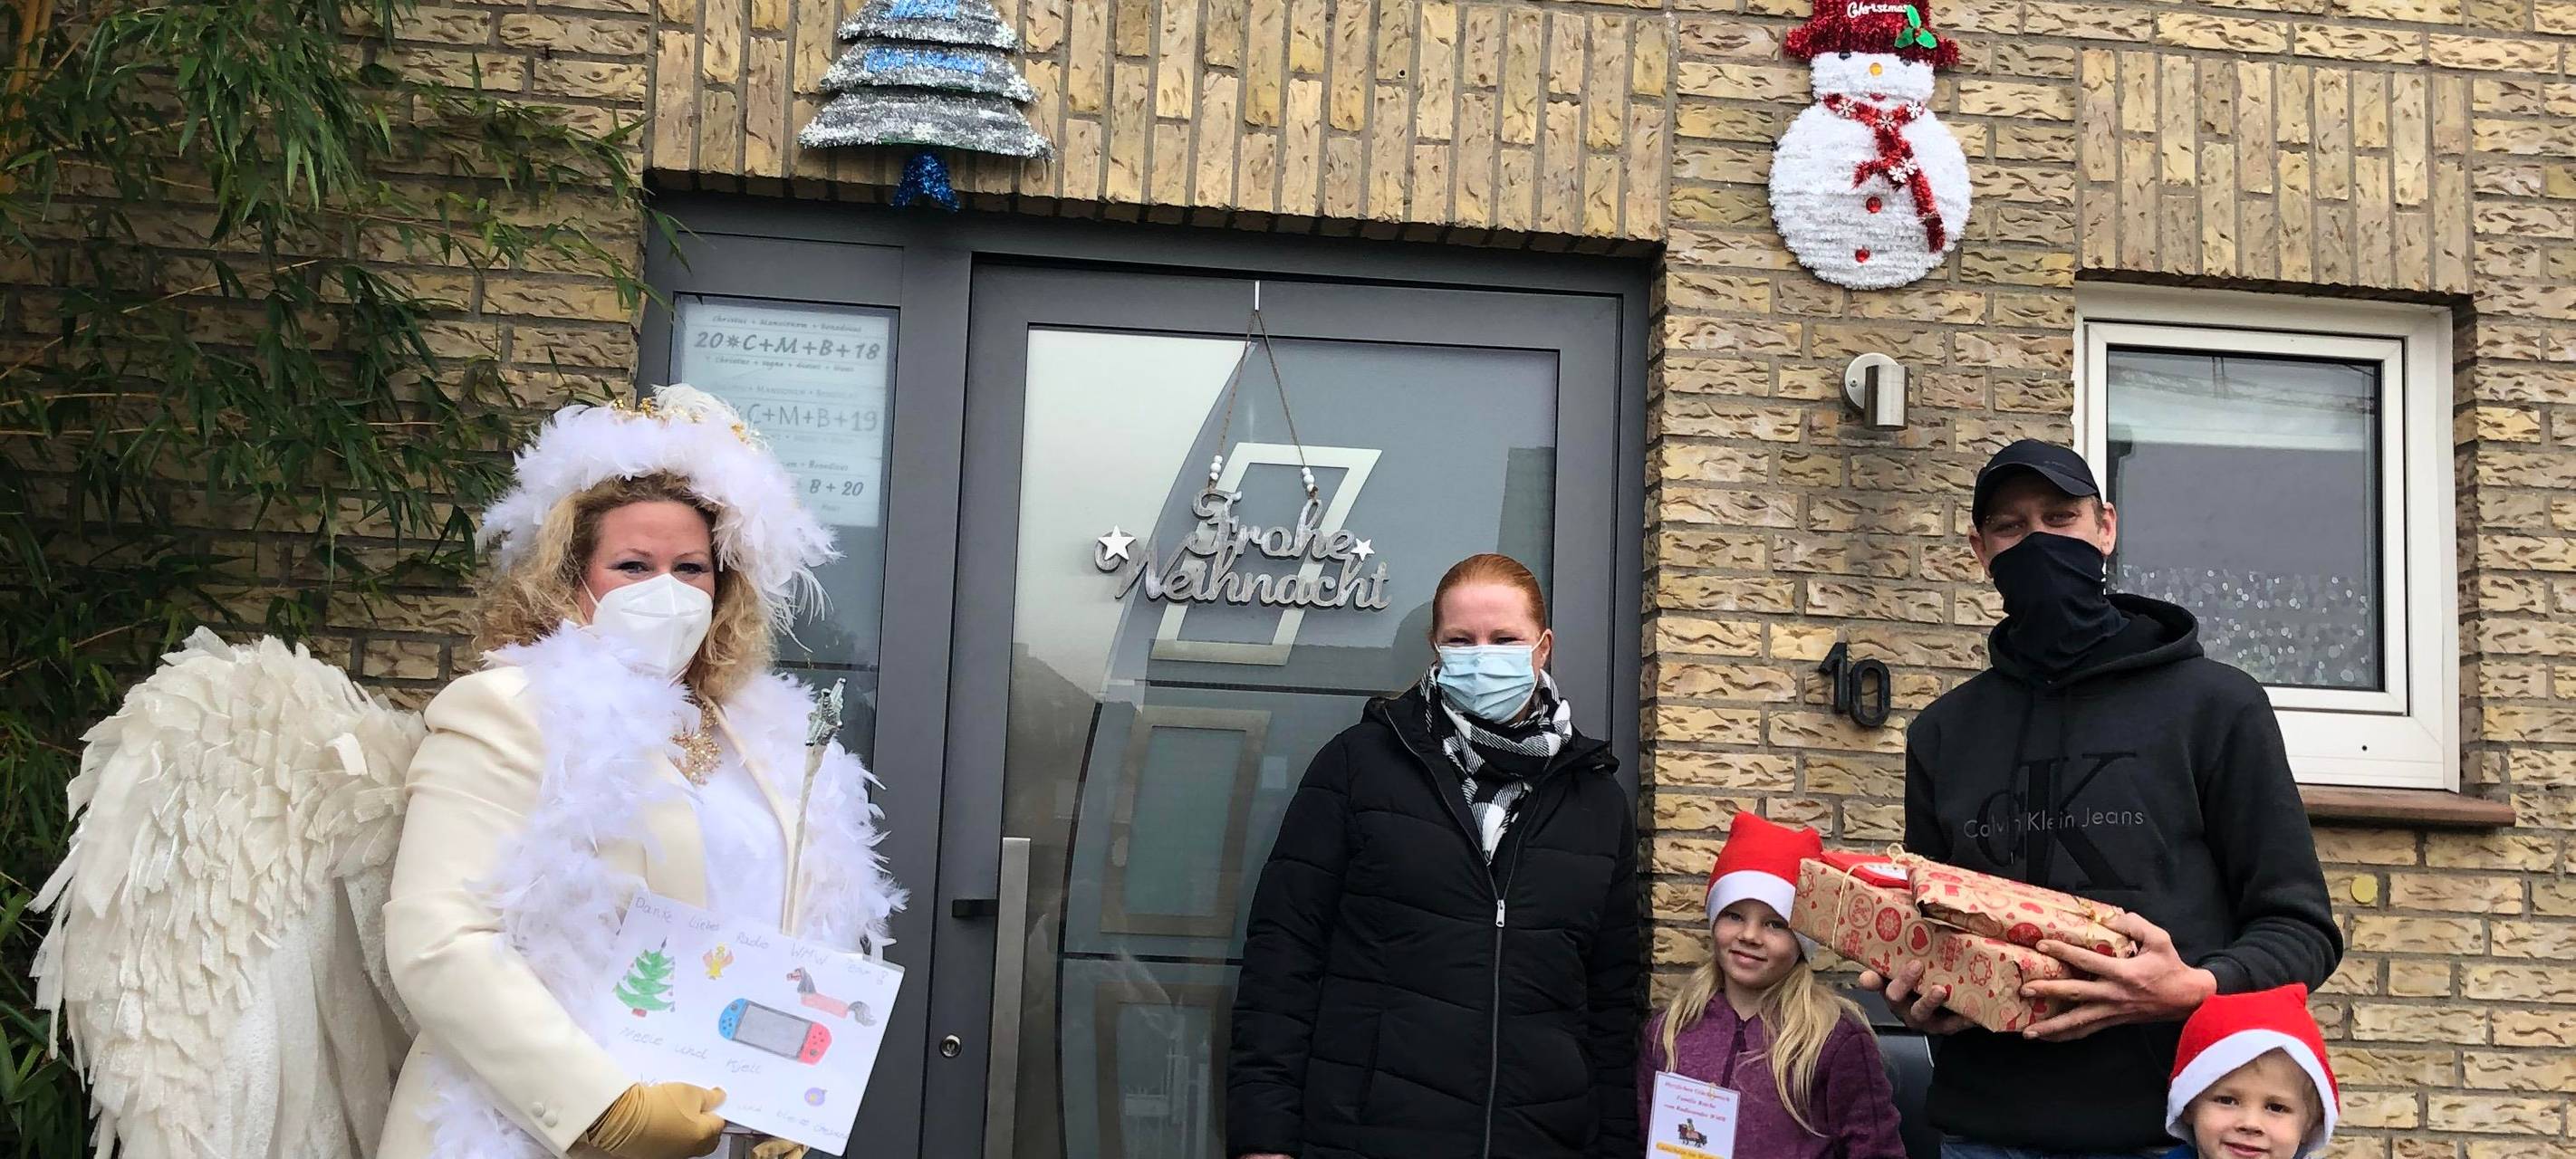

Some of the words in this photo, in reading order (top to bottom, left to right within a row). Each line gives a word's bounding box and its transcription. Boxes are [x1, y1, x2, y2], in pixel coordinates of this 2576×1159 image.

[1847, 2, 1908, 18] Christmas
[1192, 489, 1355, 561] Frohe
[1094, 532, 1392, 610] Weihnacht
[1818, 641, 1891, 727] 10
[2026, 809, 2075, 832] Klein
[2081, 806, 2145, 828] Jeans
